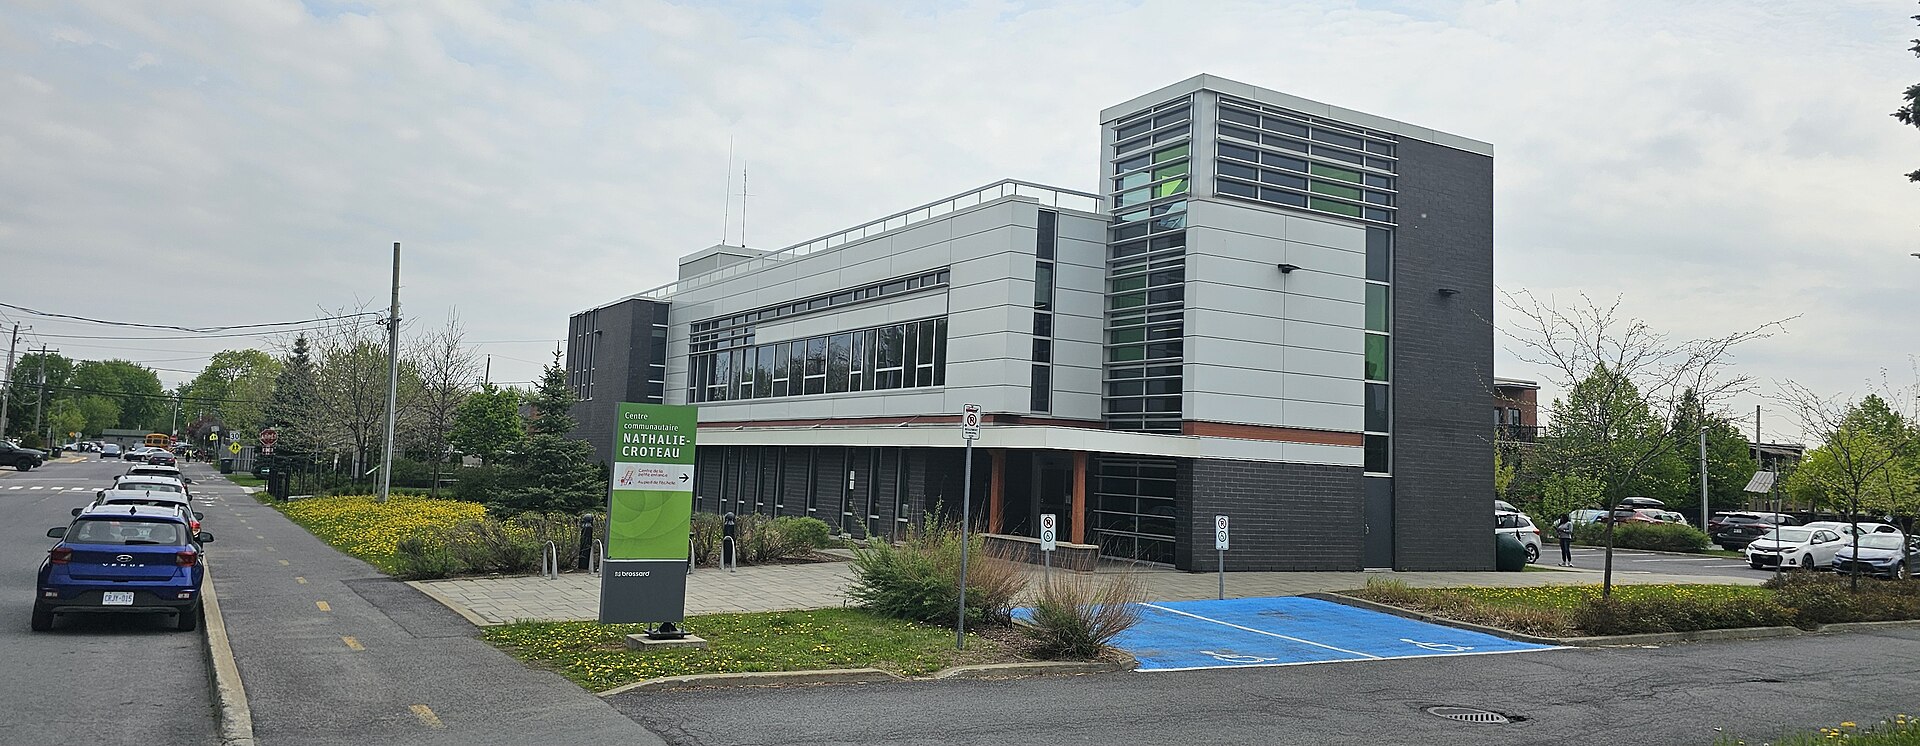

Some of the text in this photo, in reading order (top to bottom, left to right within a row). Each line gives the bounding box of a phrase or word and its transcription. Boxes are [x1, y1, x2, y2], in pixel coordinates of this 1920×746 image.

[624, 411, 648, 420] Centre
[623, 423, 679, 432] communautaire
[230, 432, 240, 440] 30
[623, 433, 691, 445] NATHALIE-
[622, 446, 680, 458] CROTEAU
